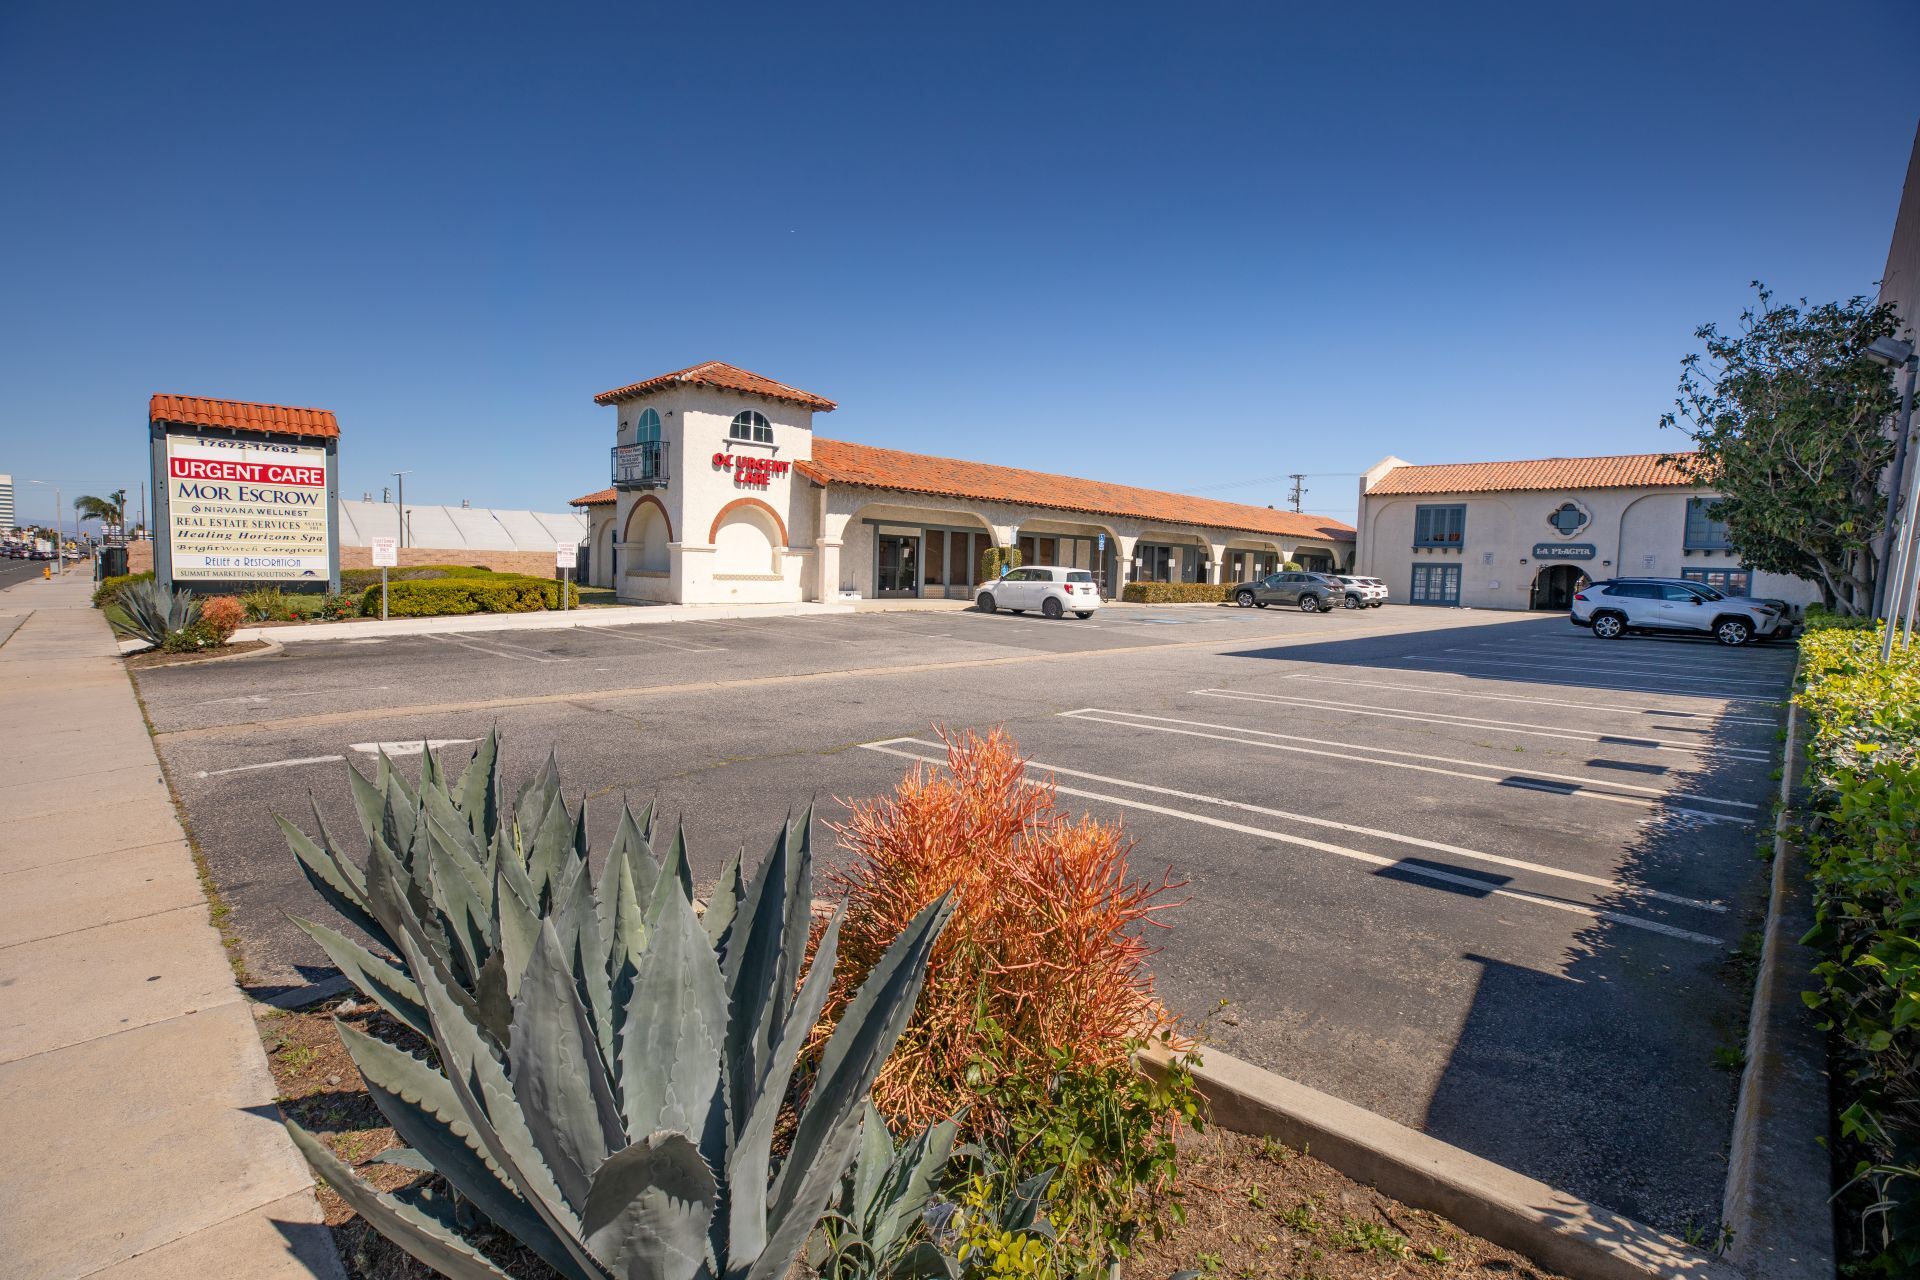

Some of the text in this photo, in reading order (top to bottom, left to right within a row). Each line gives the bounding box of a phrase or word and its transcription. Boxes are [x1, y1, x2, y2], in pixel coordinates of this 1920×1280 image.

[198, 440, 299, 454] 17672-17682
[713, 452, 791, 473] OC URGENT
[174, 460, 322, 484] URGENT CARE
[735, 470, 770, 485] CARE
[178, 482, 319, 505] MOR ESCROW
[204, 506, 308, 517] NIRVANA WELLNEST
[176, 516, 301, 530] REAL ESTATE SERVICES
[177, 530, 323, 543] Healing Horizons Spa
[263, 546, 323, 555] Caregivers
[205, 556, 231, 567] RELIEF
[244, 557, 301, 568] RESTORATION
[212, 570, 256, 578] MARKETING
[257, 570, 296, 578] SOLUTIONS
